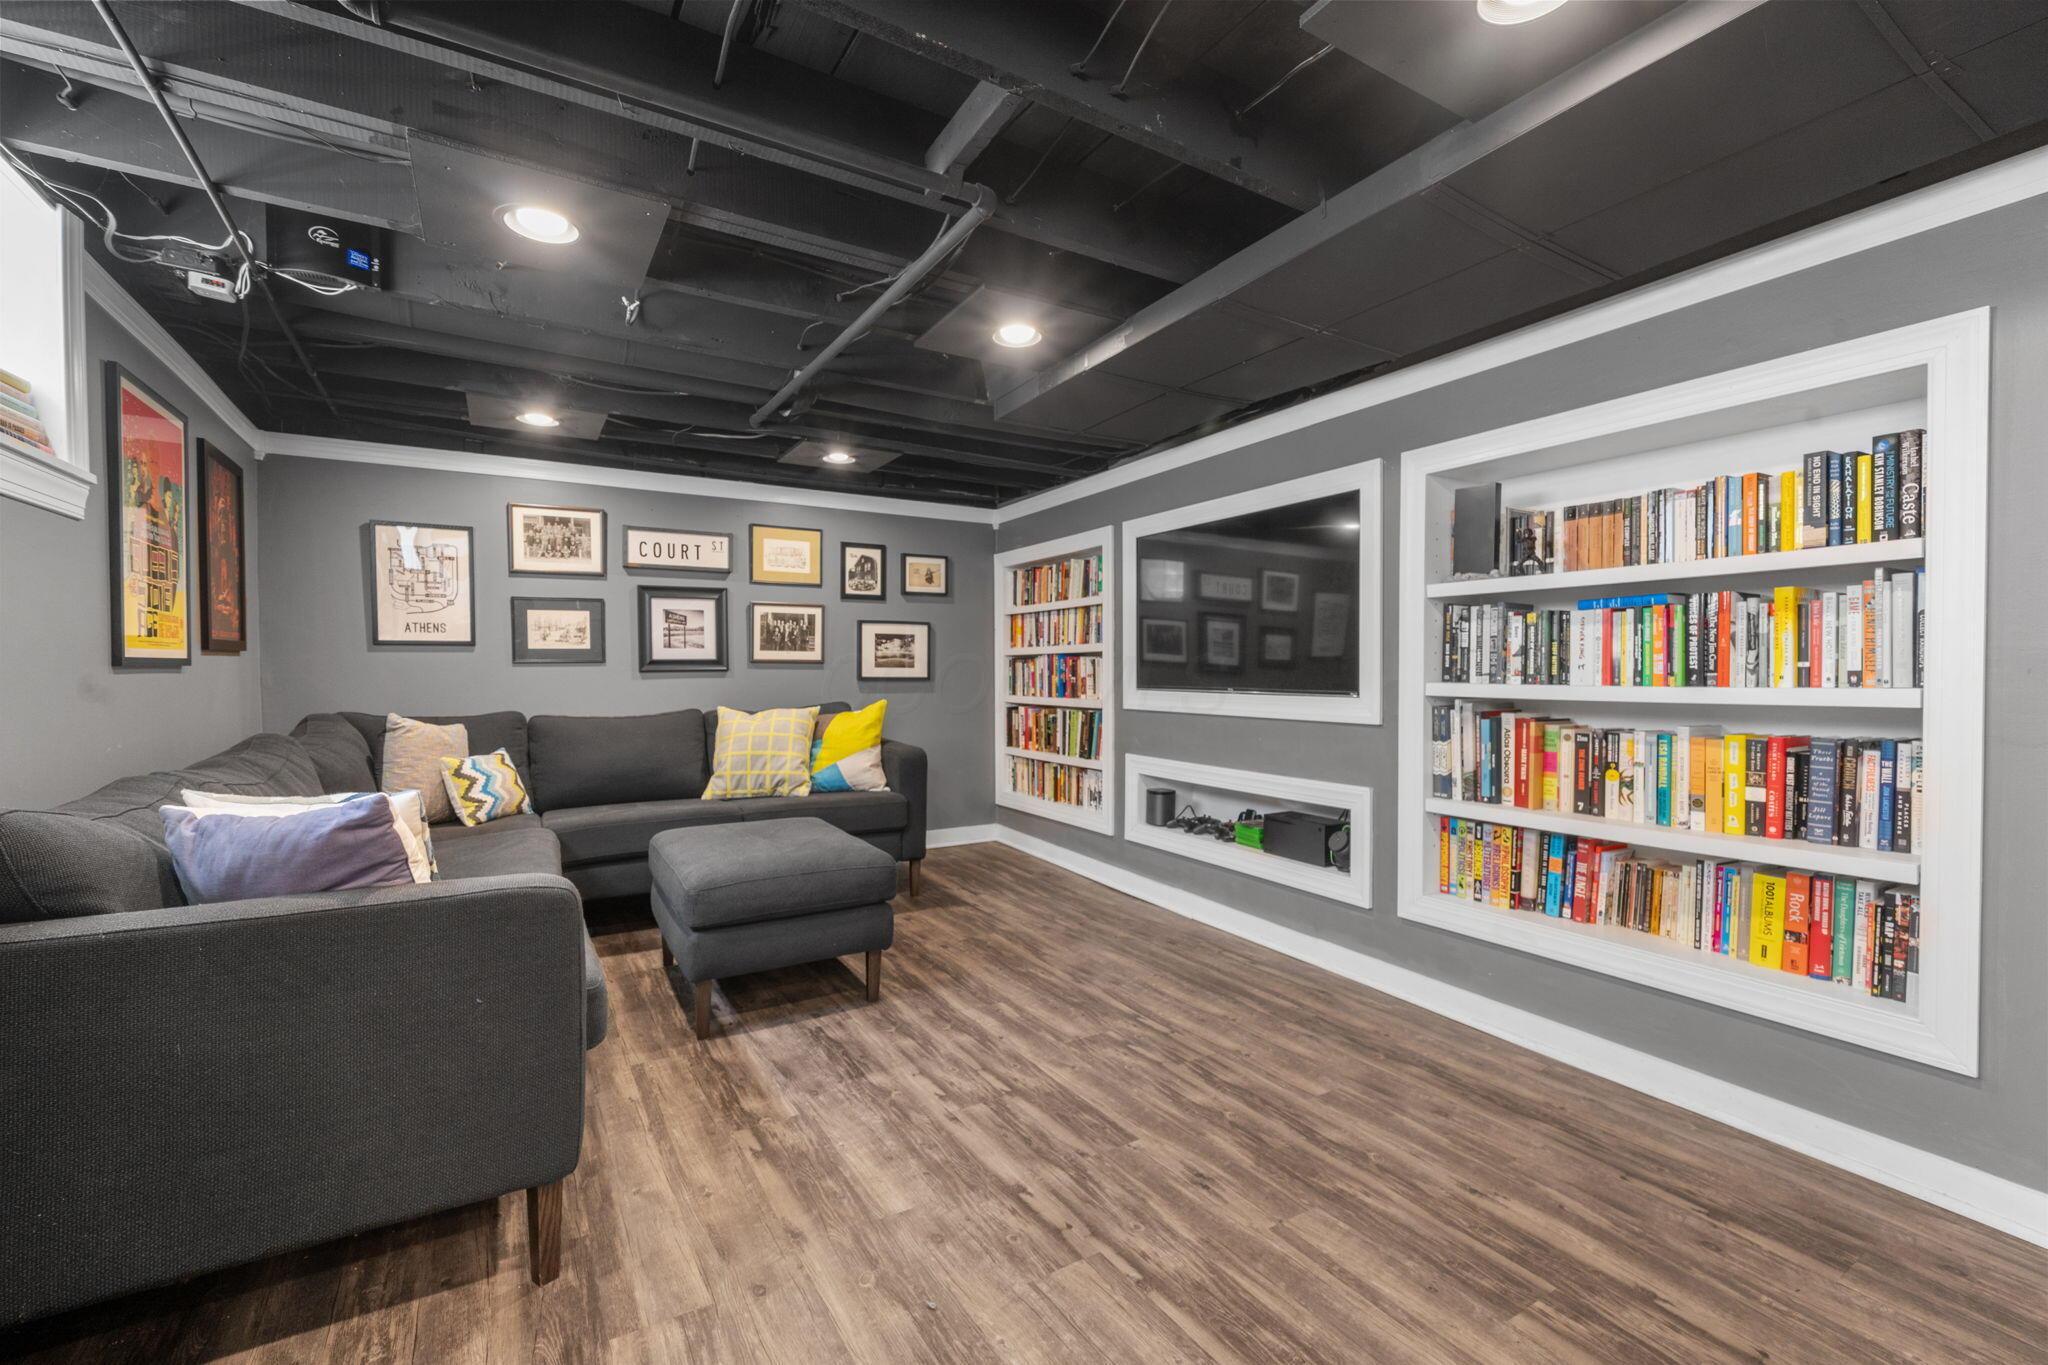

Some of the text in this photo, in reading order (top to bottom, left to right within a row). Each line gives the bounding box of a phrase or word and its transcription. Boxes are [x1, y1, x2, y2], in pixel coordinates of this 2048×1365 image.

[1886, 455, 1895, 489] MINISTRY
[1901, 440, 1911, 475] Wilkerson
[1910, 446, 1919, 467] Isabel
[1813, 456, 1821, 518] NO END IN SIGHT
[1845, 456, 1854, 520] EXHALATION
[1874, 452, 1885, 530] KIM STANLEY ROBINSON
[1886, 498, 1895, 529] FUTURE
[1902, 482, 1920, 525] Caste
[639, 540, 724, 560] COURT ST
[405, 622, 447, 633] ATHENS
[1689, 598, 1698, 669] VOICES OF PROTEST
[1825, 620, 1833, 636] NEW
[1707, 616, 1717, 671] The New Jim Crow
[1658, 739, 1668, 755] LISA
[1811, 755, 1833, 763] Truths
[1843, 757, 1856, 789] CROUCH
[1865, 754, 1876, 793] FACTFULNESS
[1881, 767, 1893, 784] WALL
[1808, 813, 1831, 821] Lepore
[1575, 862, 1588, 900] THE JUNGLE
[1762, 881, 1776, 935] 1001 ALBUMS
[1789, 892, 1805, 923] Rock
[1840, 892, 1848, 903] The
[1839, 903, 1848, 932] Daughters
[1885, 922, 1894, 938] RAP
